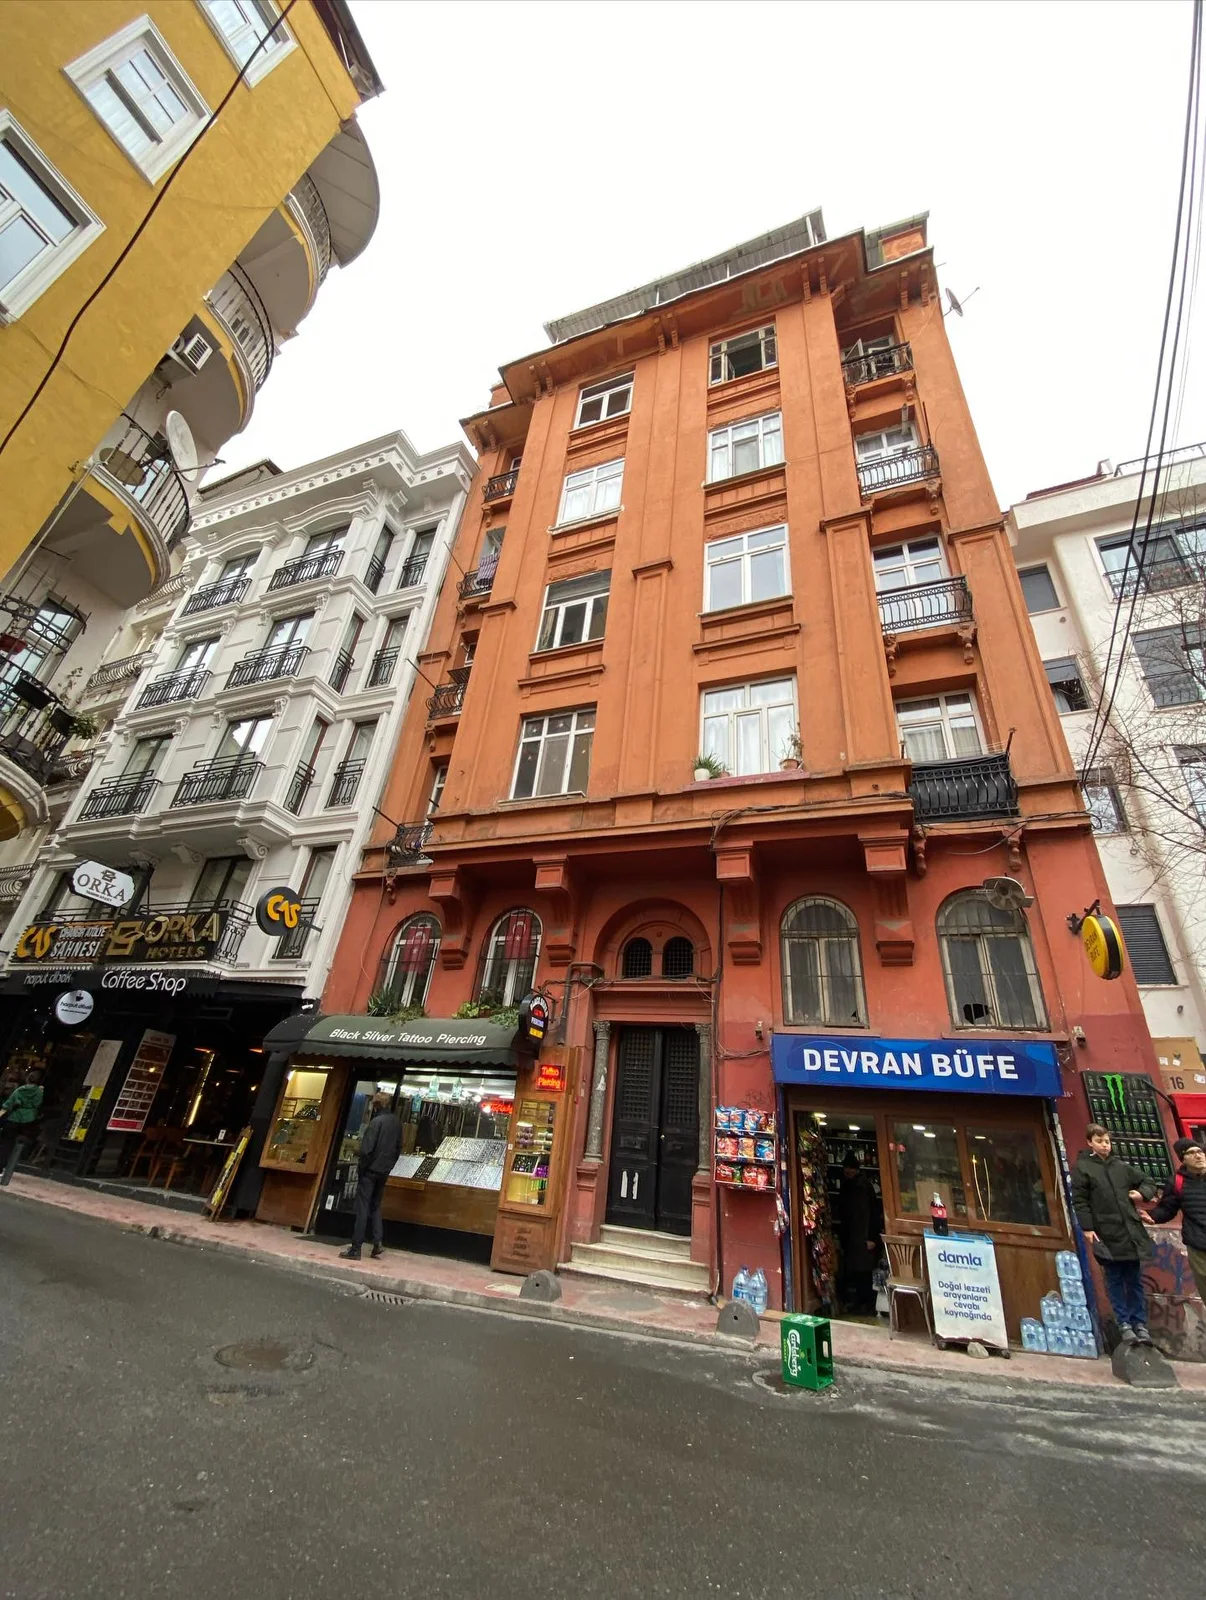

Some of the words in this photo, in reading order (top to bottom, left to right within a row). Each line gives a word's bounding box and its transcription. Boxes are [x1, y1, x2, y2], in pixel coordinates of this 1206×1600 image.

[77, 873, 125, 902] ORKA
[145, 912, 220, 943] ORKA
[145, 946, 206, 959] HOTELS
[101, 971, 146, 989] Coffee
[146, 972, 187, 997] Shop
[329, 1028, 361, 1040] Black
[362, 1030, 395, 1042] Silver
[398, 1032, 433, 1044] Tattoo
[436, 1033, 487, 1046] Piercing
[803, 1048, 923, 1076] DEVRAN
[931, 1048, 1019, 1080] BÜFE
[1169, 1076, 1185, 1090] 16
[938, 1250, 982, 1267] damla
[938, 1280, 962, 1292] Doğal
[964, 1283, 991, 1294] lezzeti
[943, 1291, 988, 1303] arayanlara
[954, 1301, 980, 1310] cevabı
[944, 1308, 993, 1321] kaynağında
[787, 1329, 801, 1377] Carlsberg
